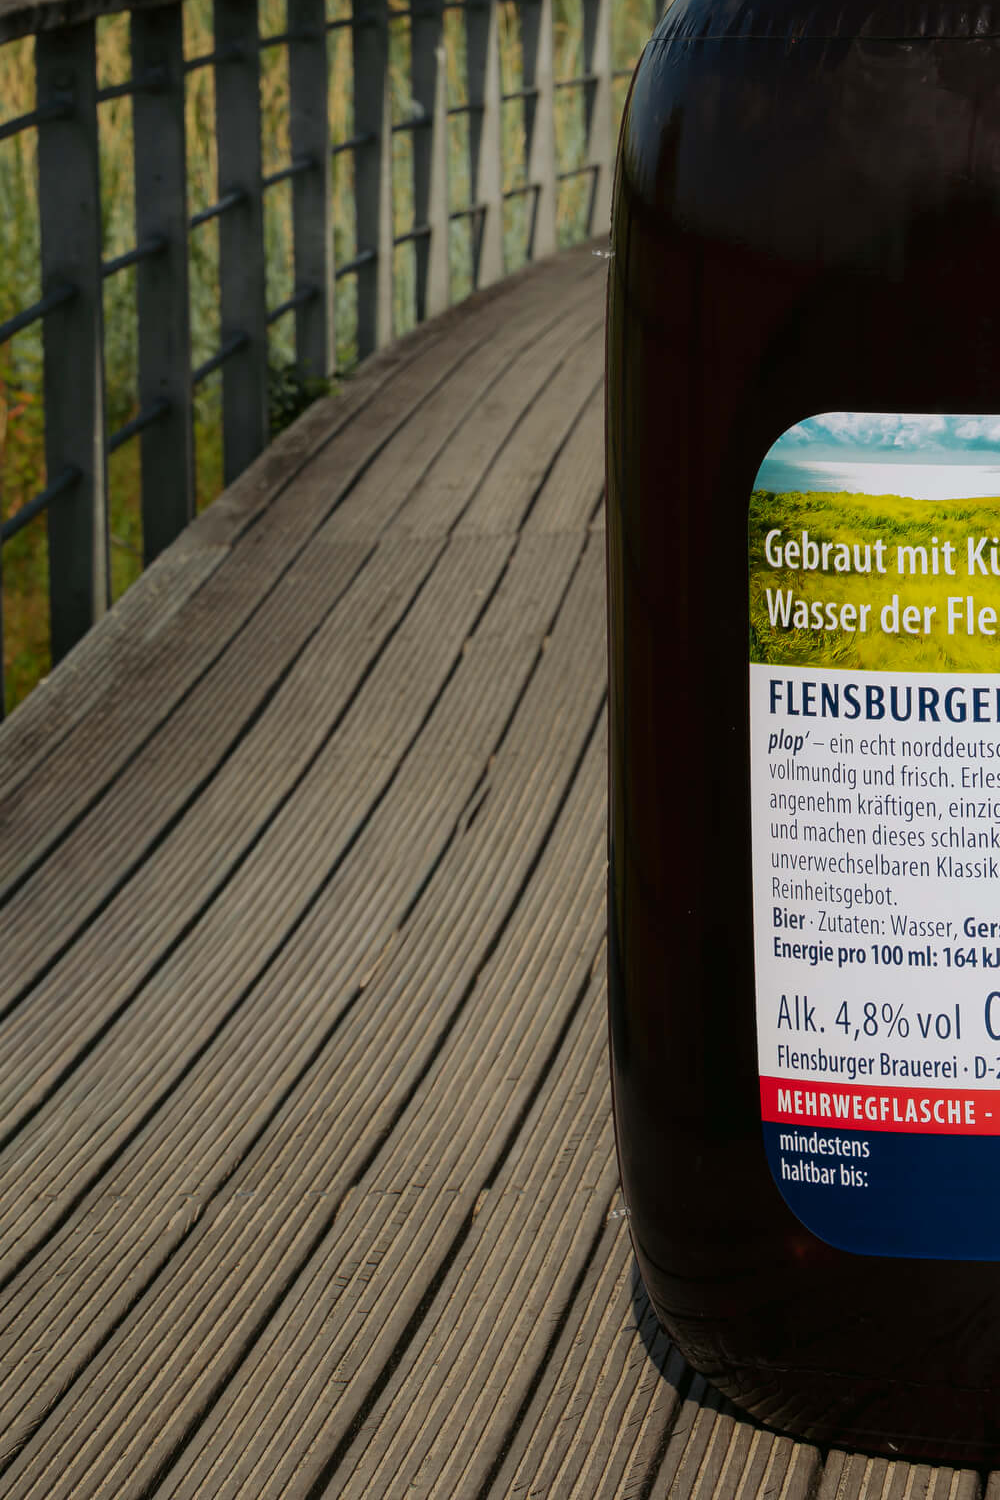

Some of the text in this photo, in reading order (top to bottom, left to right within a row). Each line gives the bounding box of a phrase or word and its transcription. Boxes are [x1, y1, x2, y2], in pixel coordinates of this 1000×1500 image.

[766, 530, 887, 573] Gebraut
[898, 537, 955, 575] mit
[766, 589, 871, 632] Wasser
[881, 595, 936, 634] der
[830, 734, 853, 753] ein
[860, 734, 895, 756] echt
[770, 759, 856, 789] vollmundig
[864, 765, 894, 785] und
[901, 765, 954, 787] frisch.
[770, 792, 851, 815] angenehm
[858, 794, 941, 822] kräftigen,
[771, 819, 797, 839] und
[804, 822, 865, 844] machen
[873, 824, 925, 846] dieses
[772, 852, 929, 876] unverwechselbaren
[773, 877, 896, 909] Reinheitsgebot.
[774, 907, 805, 929] Bier
[819, 911, 884, 935] Zutaten:
[891, 915, 957, 940] Wasser,
[774, 937, 833, 965] Energie
[838, 948, 866, 967] pro
[872, 945, 903, 965] 100
[909, 946, 937, 966] ml:
[943, 948, 977, 967] 164
[983, 947, 1000, 967] kJ
[778, 995, 824, 1032] Alk.
[836, 1001, 909, 1041] 4,8%
[917, 1004, 960, 1039] vol
[778, 1045, 874, 1079] Flensburger
[880, 1053, 957, 1078] Brauerei
[778, 1089, 975, 1124] MEHRWEGFLASCHE
[780, 1131, 869, 1157] mindestens
[782, 1158, 868, 1187] haltbar bis:
